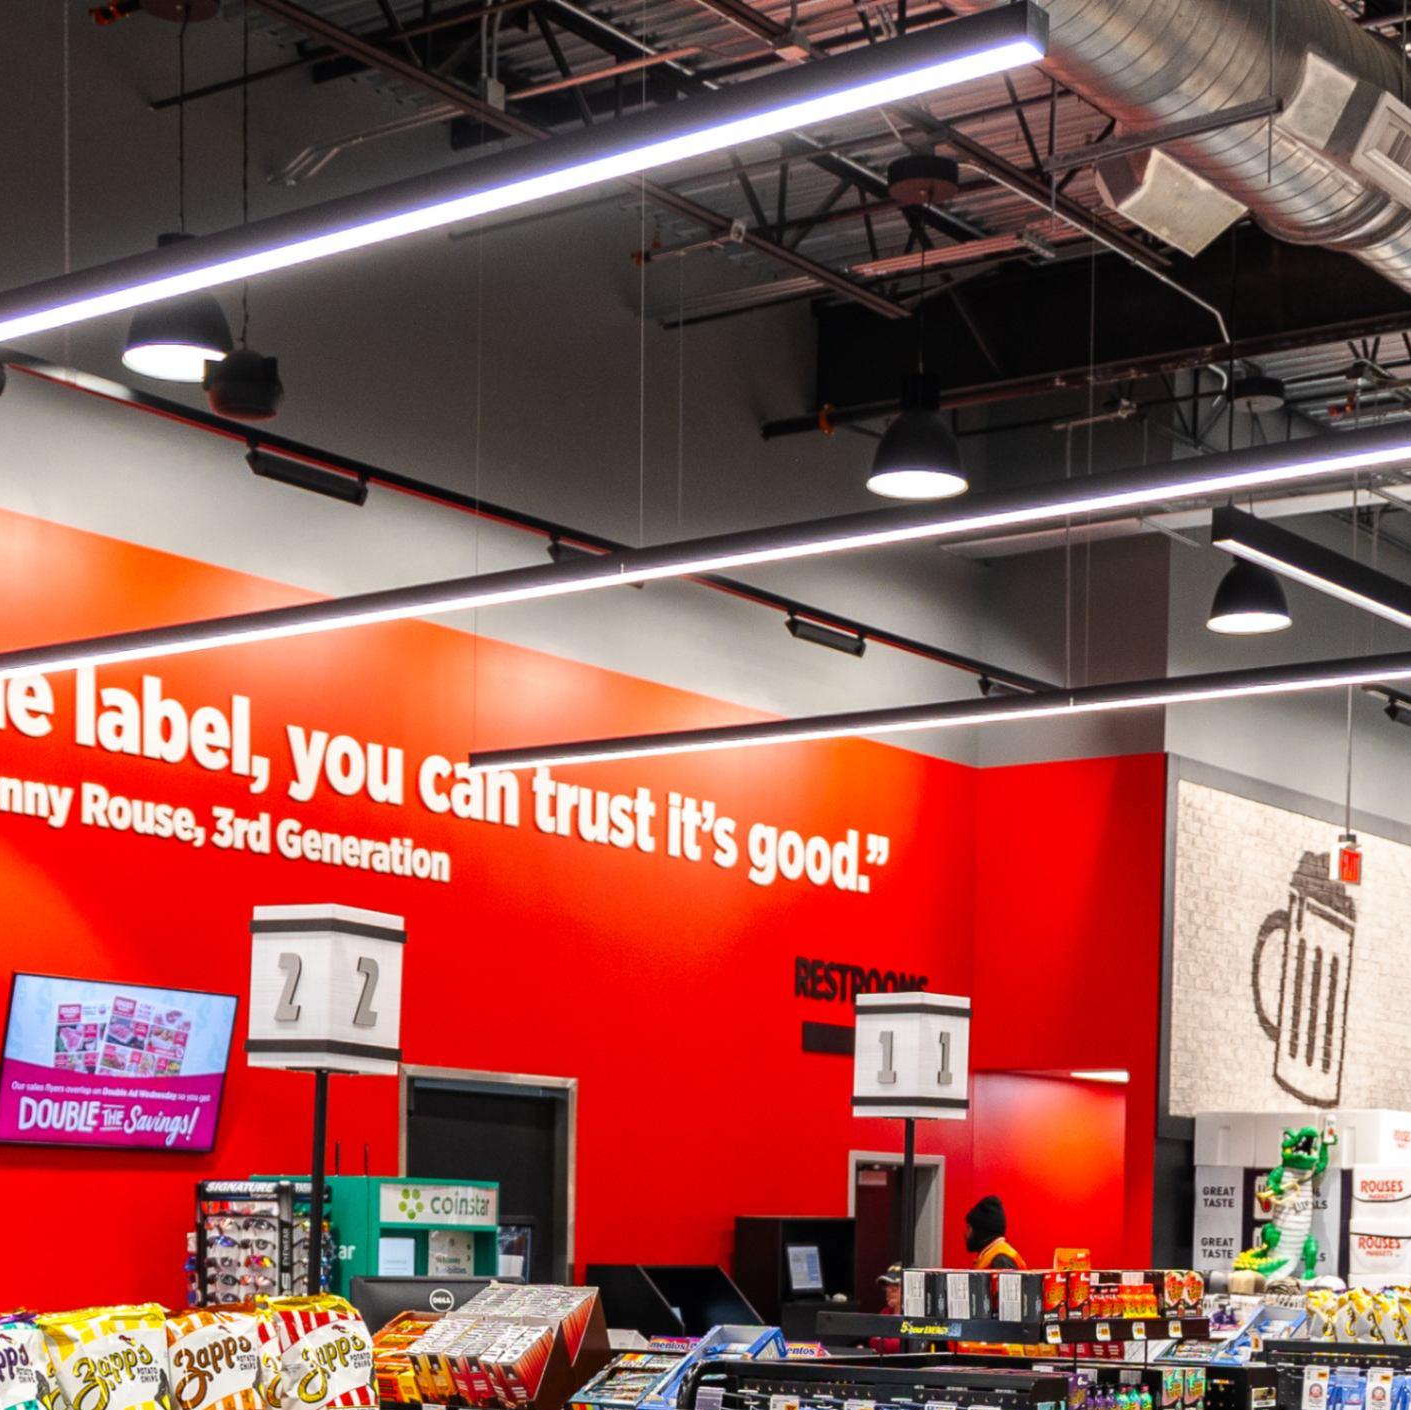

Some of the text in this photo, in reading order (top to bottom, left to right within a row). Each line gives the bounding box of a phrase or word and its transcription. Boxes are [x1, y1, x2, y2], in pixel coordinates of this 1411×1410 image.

[75, 664, 270, 793] label,
[286, 724, 404, 805] you
[419, 752, 518, 829] can
[532, 763, 656, 858] trust
[666, 791, 737, 871] it's
[81, 783, 206, 847] Rouse,
[212, 806, 270, 857] 3rd
[276, 816, 451, 883] Generation
[276, 952, 380, 1028] 2 2
[877, 1030, 953, 1085] 1 1
[18, 1096, 201, 1146] DOUBLE THE Savings!
[205, 1182, 275, 1193] SIGNATURE
[1202, 1186, 1236, 1196] GREAT
[1360, 1180, 1404, 1193] ROUSES
[430, 1190, 490, 1217] coinstar
[1203, 1198, 1236, 1208] TASTE
[433, 1296, 451, 1304] DELL
